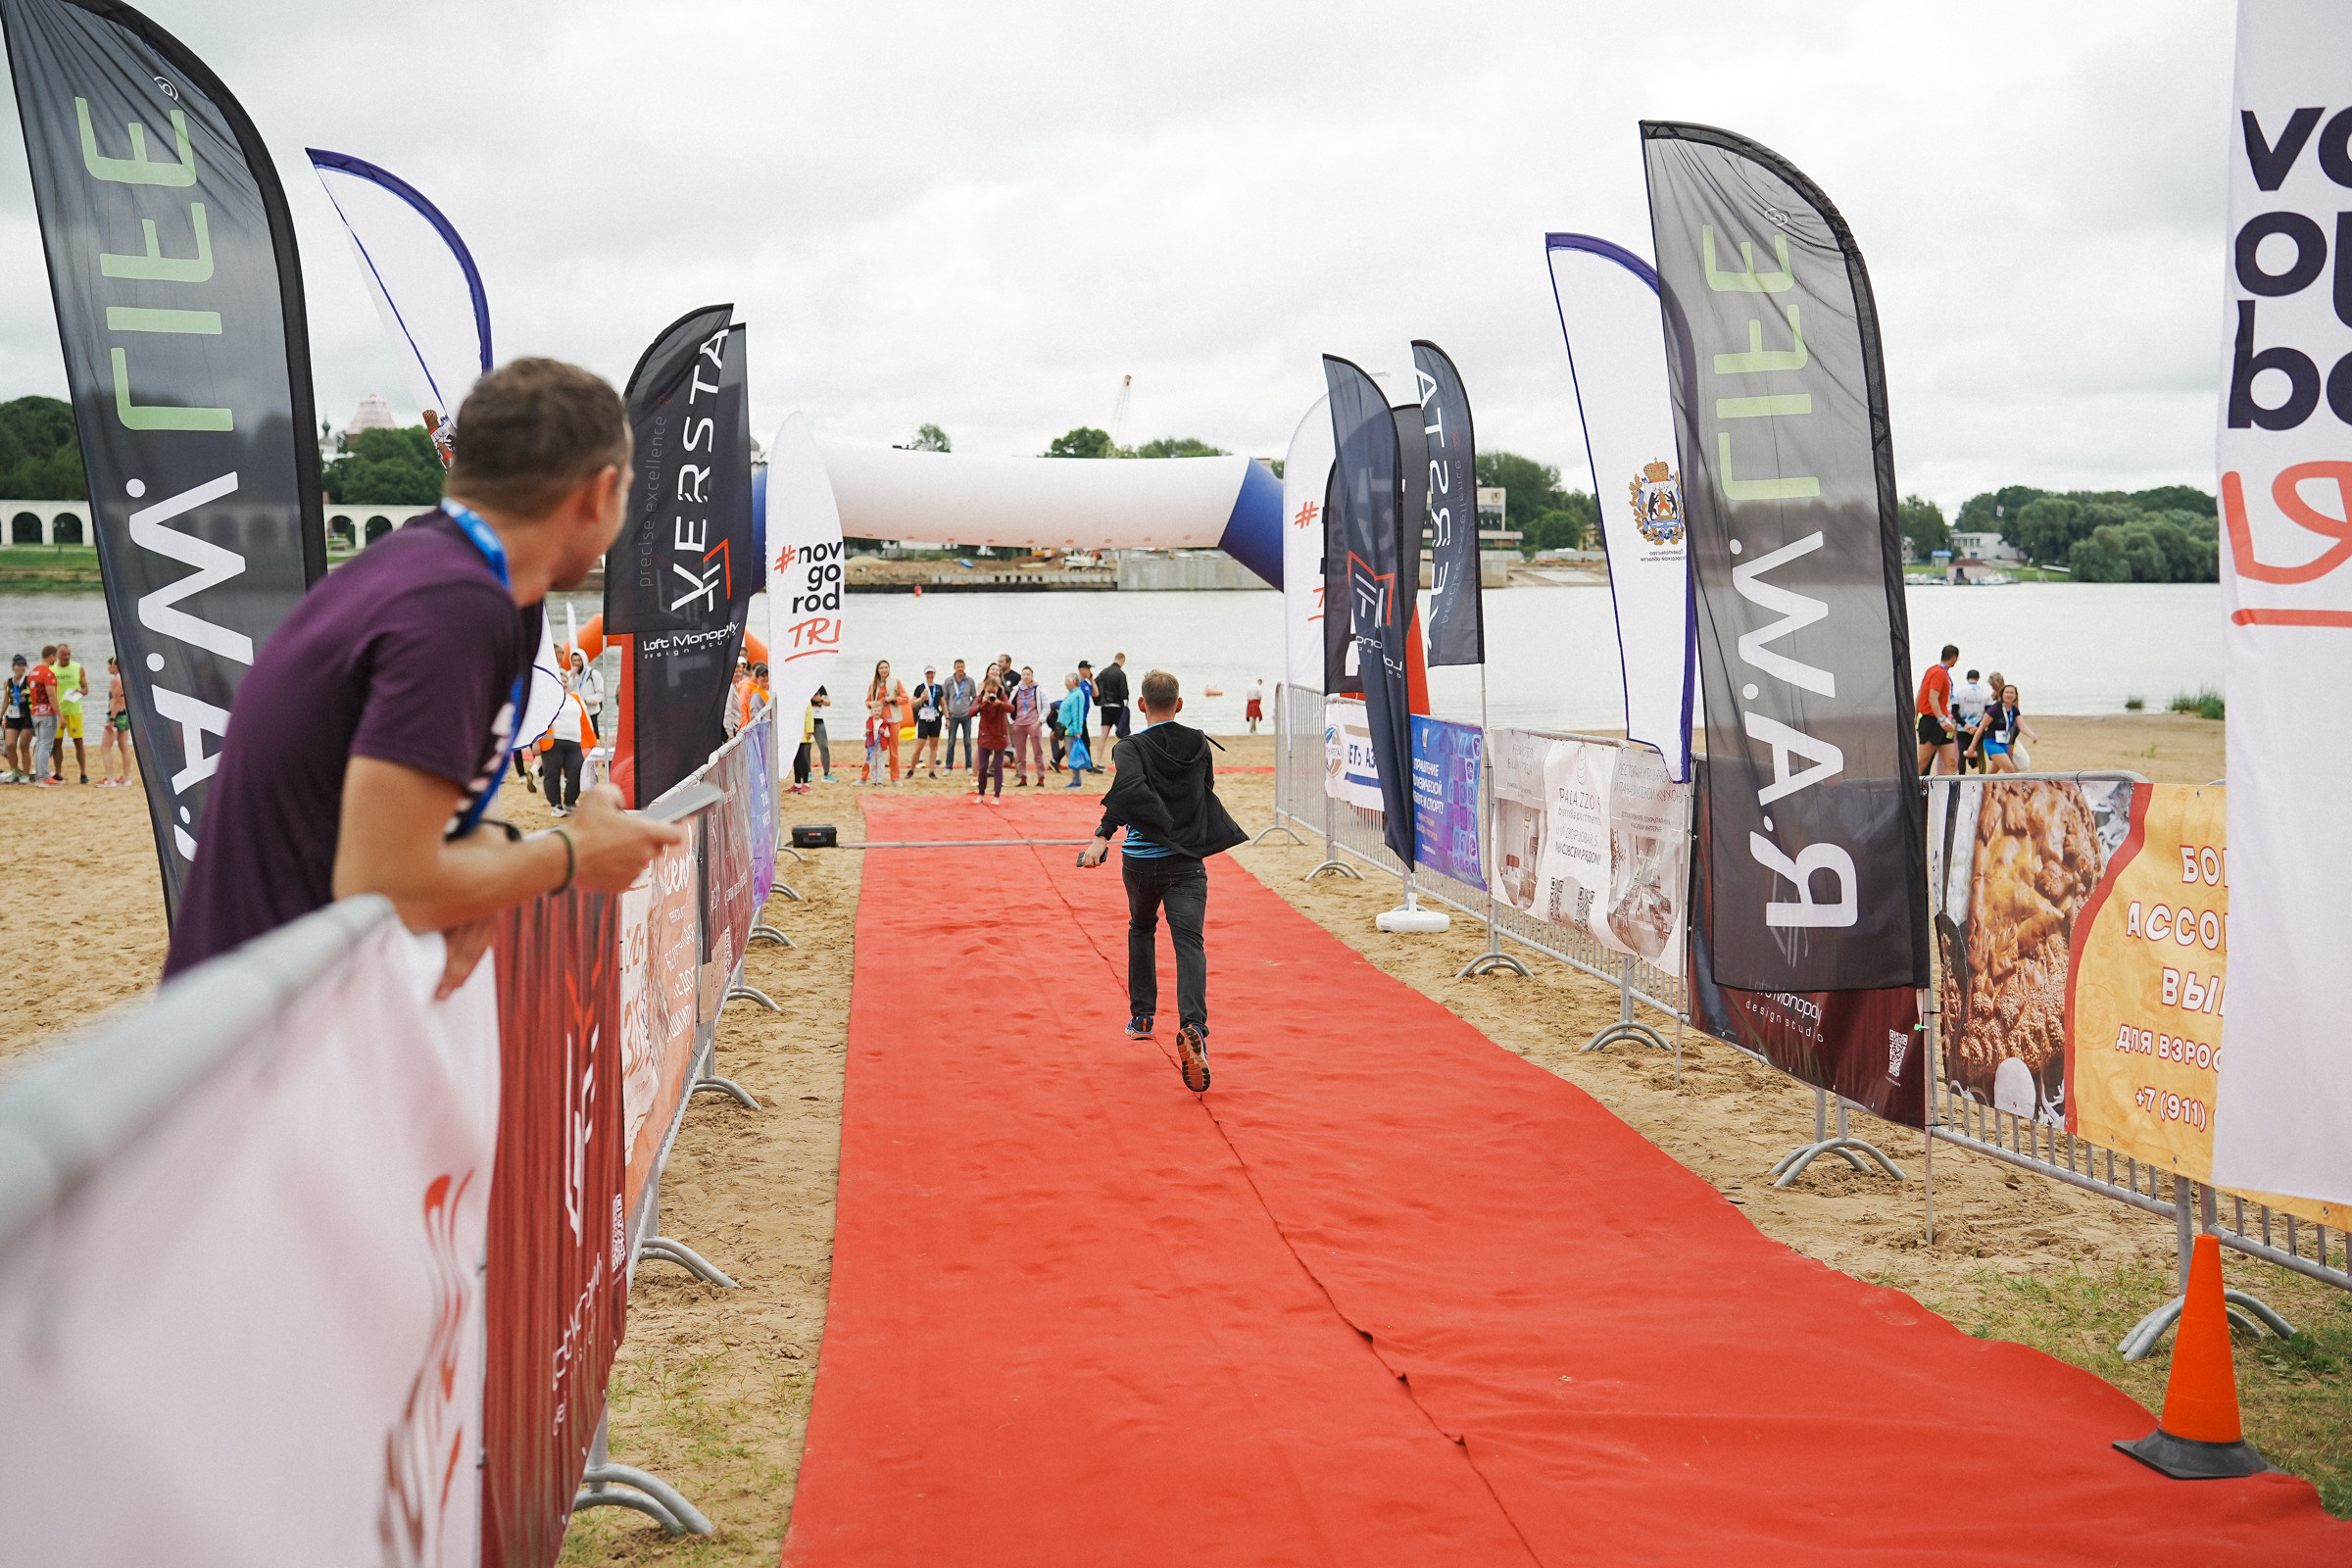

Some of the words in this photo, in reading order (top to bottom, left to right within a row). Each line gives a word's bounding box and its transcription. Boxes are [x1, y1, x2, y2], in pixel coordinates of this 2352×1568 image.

[645, 416, 667, 514] excellence
[670, 328, 730, 612] VERSTA
[639, 518, 655, 588] precise
[774, 542, 843, 574] #nov
[792, 582, 841, 613] rod
[807, 564, 842, 592] go
[643, 638, 669, 651] Loft
[788, 617, 841, 648] TRI
[1559, 787, 1595, 809] PALAZZO
[2180, 846, 2229, 888] БО
[2127, 901, 2229, 953] АССО
[2161, 966, 2226, 1017] ВЫ
[1746, 999, 1782, 1024] design
[1785, 1018, 1824, 1043] studio
[2115, 1024, 2154, 1055] ДЛЯ
[2135, 1087, 2156, 1111] +7
[2160, 1091, 2207, 1133] (911)
